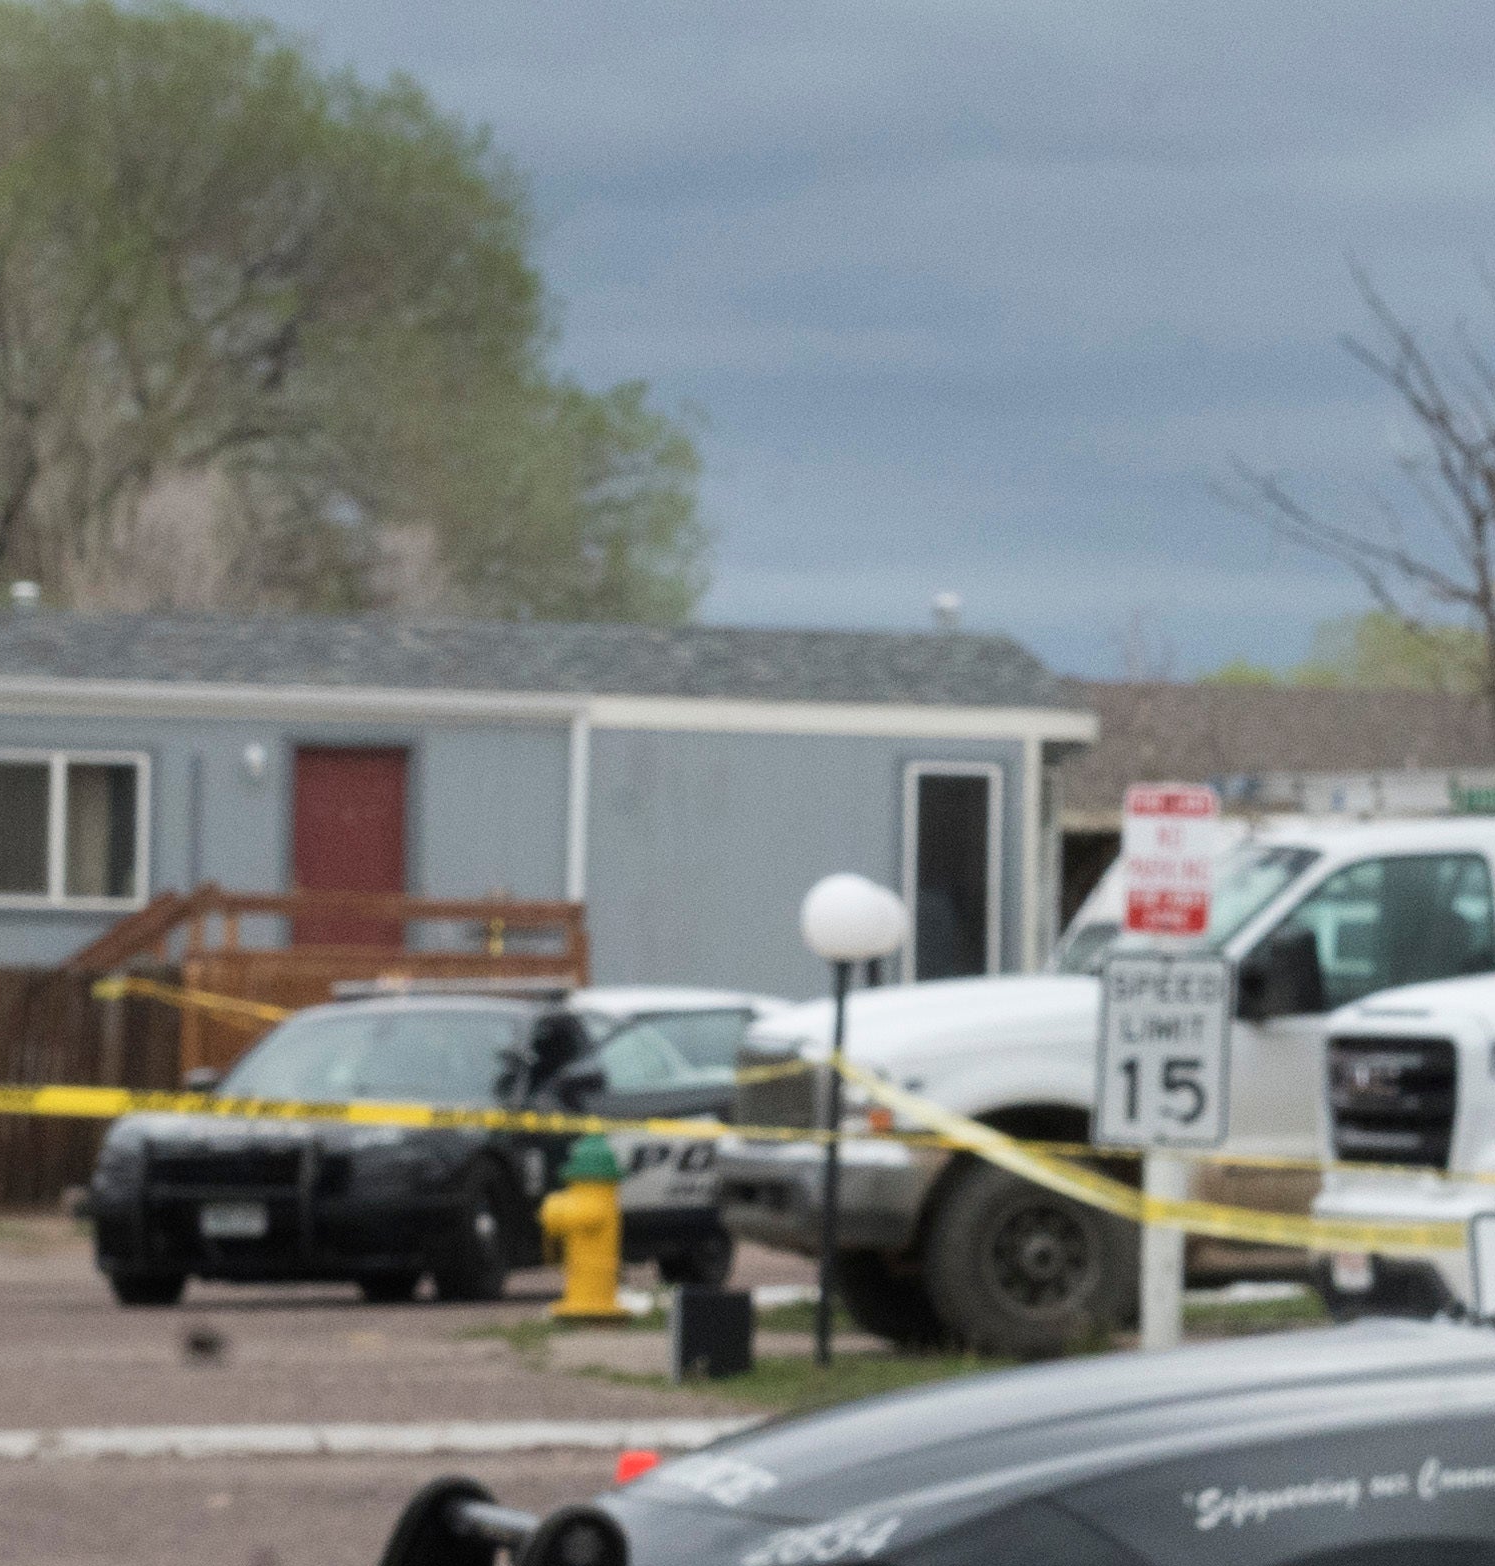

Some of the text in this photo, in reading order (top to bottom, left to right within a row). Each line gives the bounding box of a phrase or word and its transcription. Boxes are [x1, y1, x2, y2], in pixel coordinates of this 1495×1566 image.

[1111, 972, 1222, 1003] SPEED
[1119, 1014, 1205, 1042] LIMIT
[1119, 1055, 1208, 1126] 15
